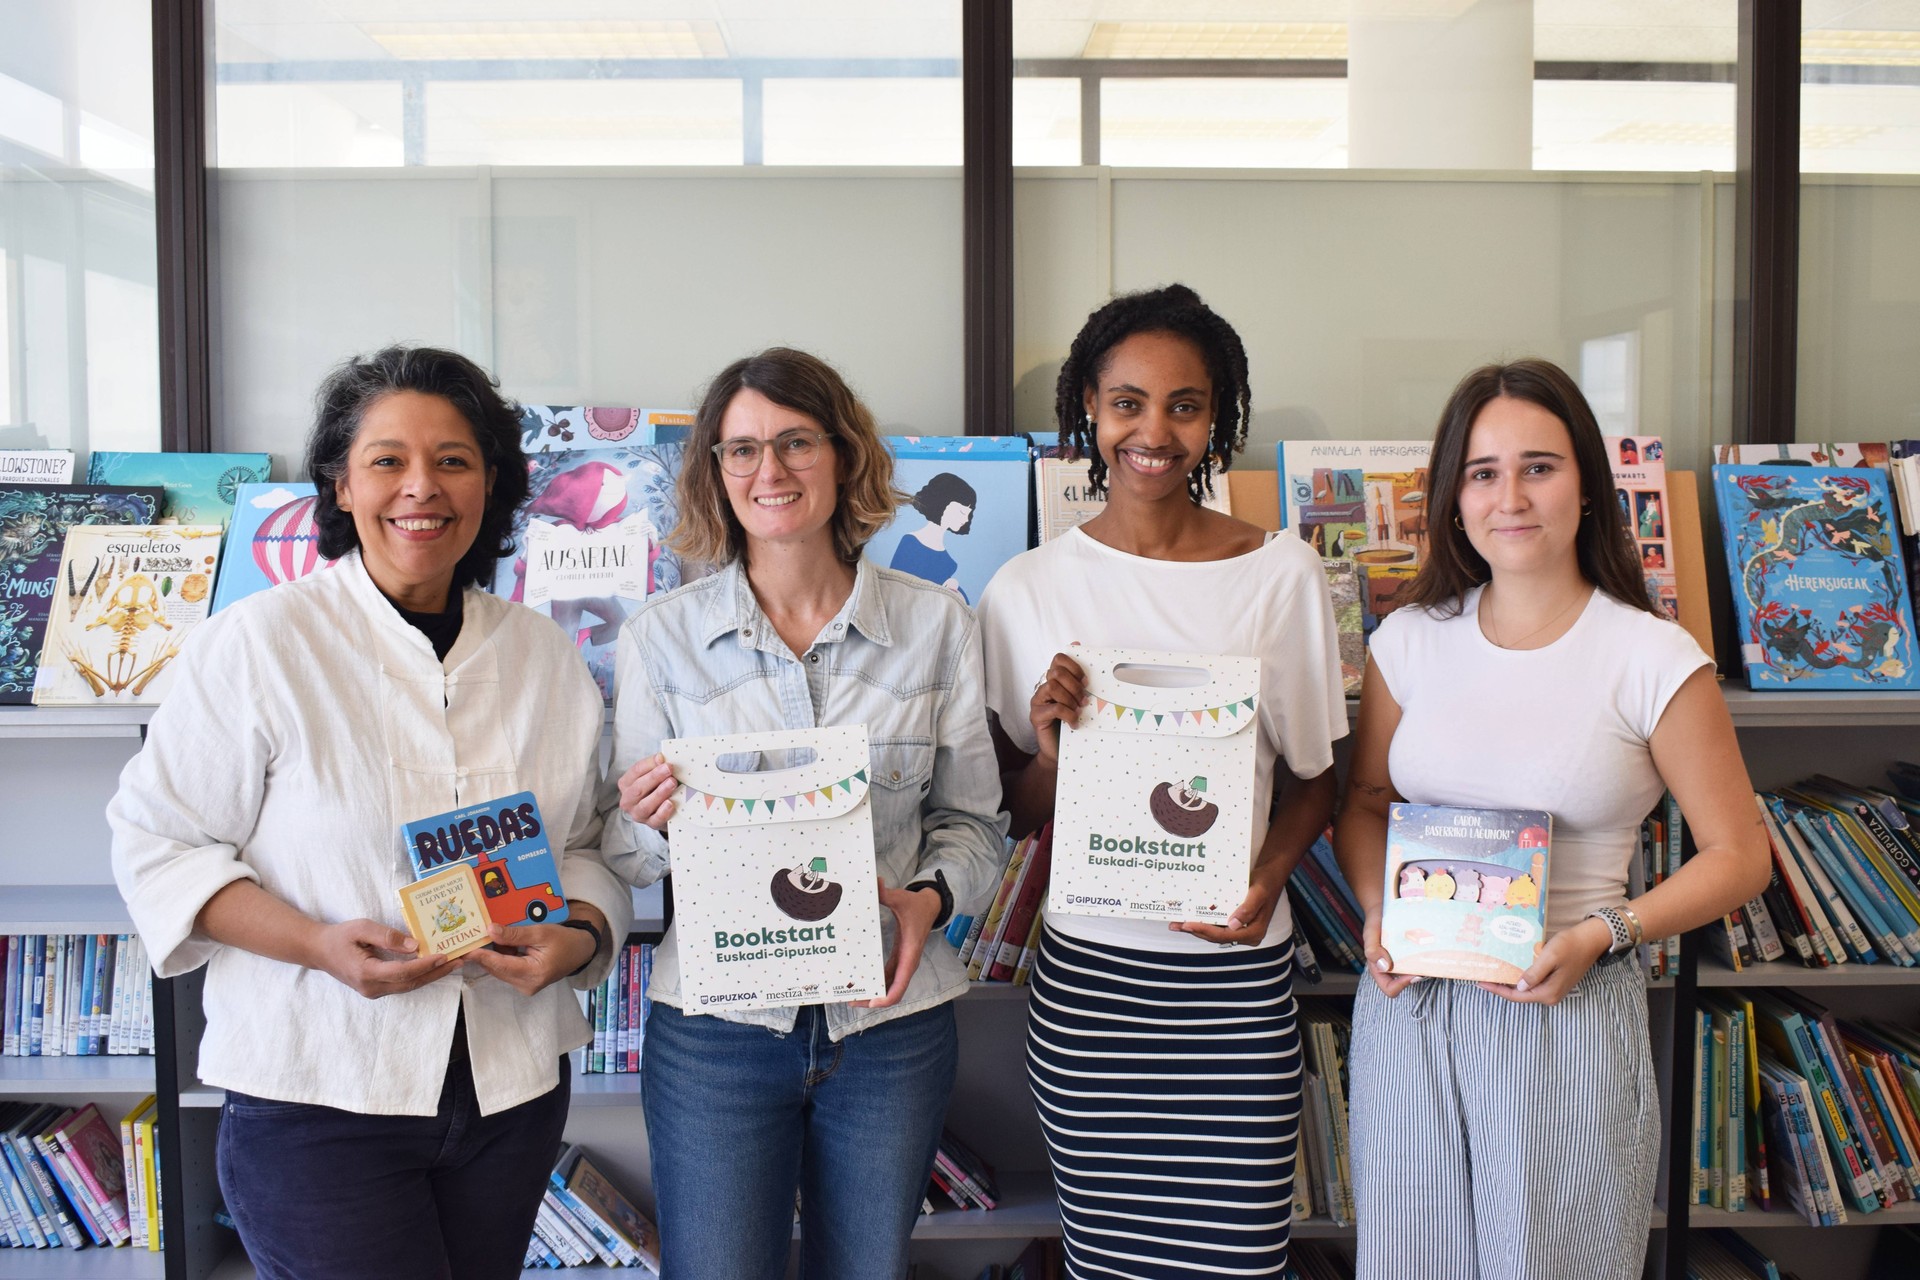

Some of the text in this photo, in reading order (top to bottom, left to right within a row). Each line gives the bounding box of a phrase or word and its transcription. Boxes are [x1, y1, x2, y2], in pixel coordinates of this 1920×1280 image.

[1311, 446, 1361, 456] ANIMALIA
[0, 457, 66, 474] LOWSTONE?
[1064, 486, 1078, 501] EL
[106, 539, 181, 557] esqueletos
[538, 545, 635, 572] AUSARTAK
[1785, 574, 1873, 593] HERENSUGEAK
[415, 803, 540, 868] RUEDAS
[1425, 825, 1468, 838] BASERRIKO
[1671, 828, 1679, 837] TE
[1089, 833, 1206, 858] Bookstart
[1671, 840, 1679, 852] LO
[1867, 817, 1911, 868] GORPUTZA
[517, 848, 547, 862] BOMBEROS
[1088, 854, 1205, 873] Euskadi-Gipuzkoa
[426, 890, 447, 904] LOVE
[448, 884, 464, 896] YOU
[1076, 896, 1122, 906] GIPUZKOA
[1130, 902, 1166, 912] mestiza
[436, 926, 482, 953] AUTUMN
[714, 922, 836, 948] Bookstart
[716, 944, 836, 963] Euskadi-Gipuzkoa
[710, 992, 758, 1003] GIPUZKOA
[766, 988, 802, 1000] mestiza
[1824, 1095, 1835, 1115] MEJOR
[1832, 1115, 1844, 1135] MUSEO
